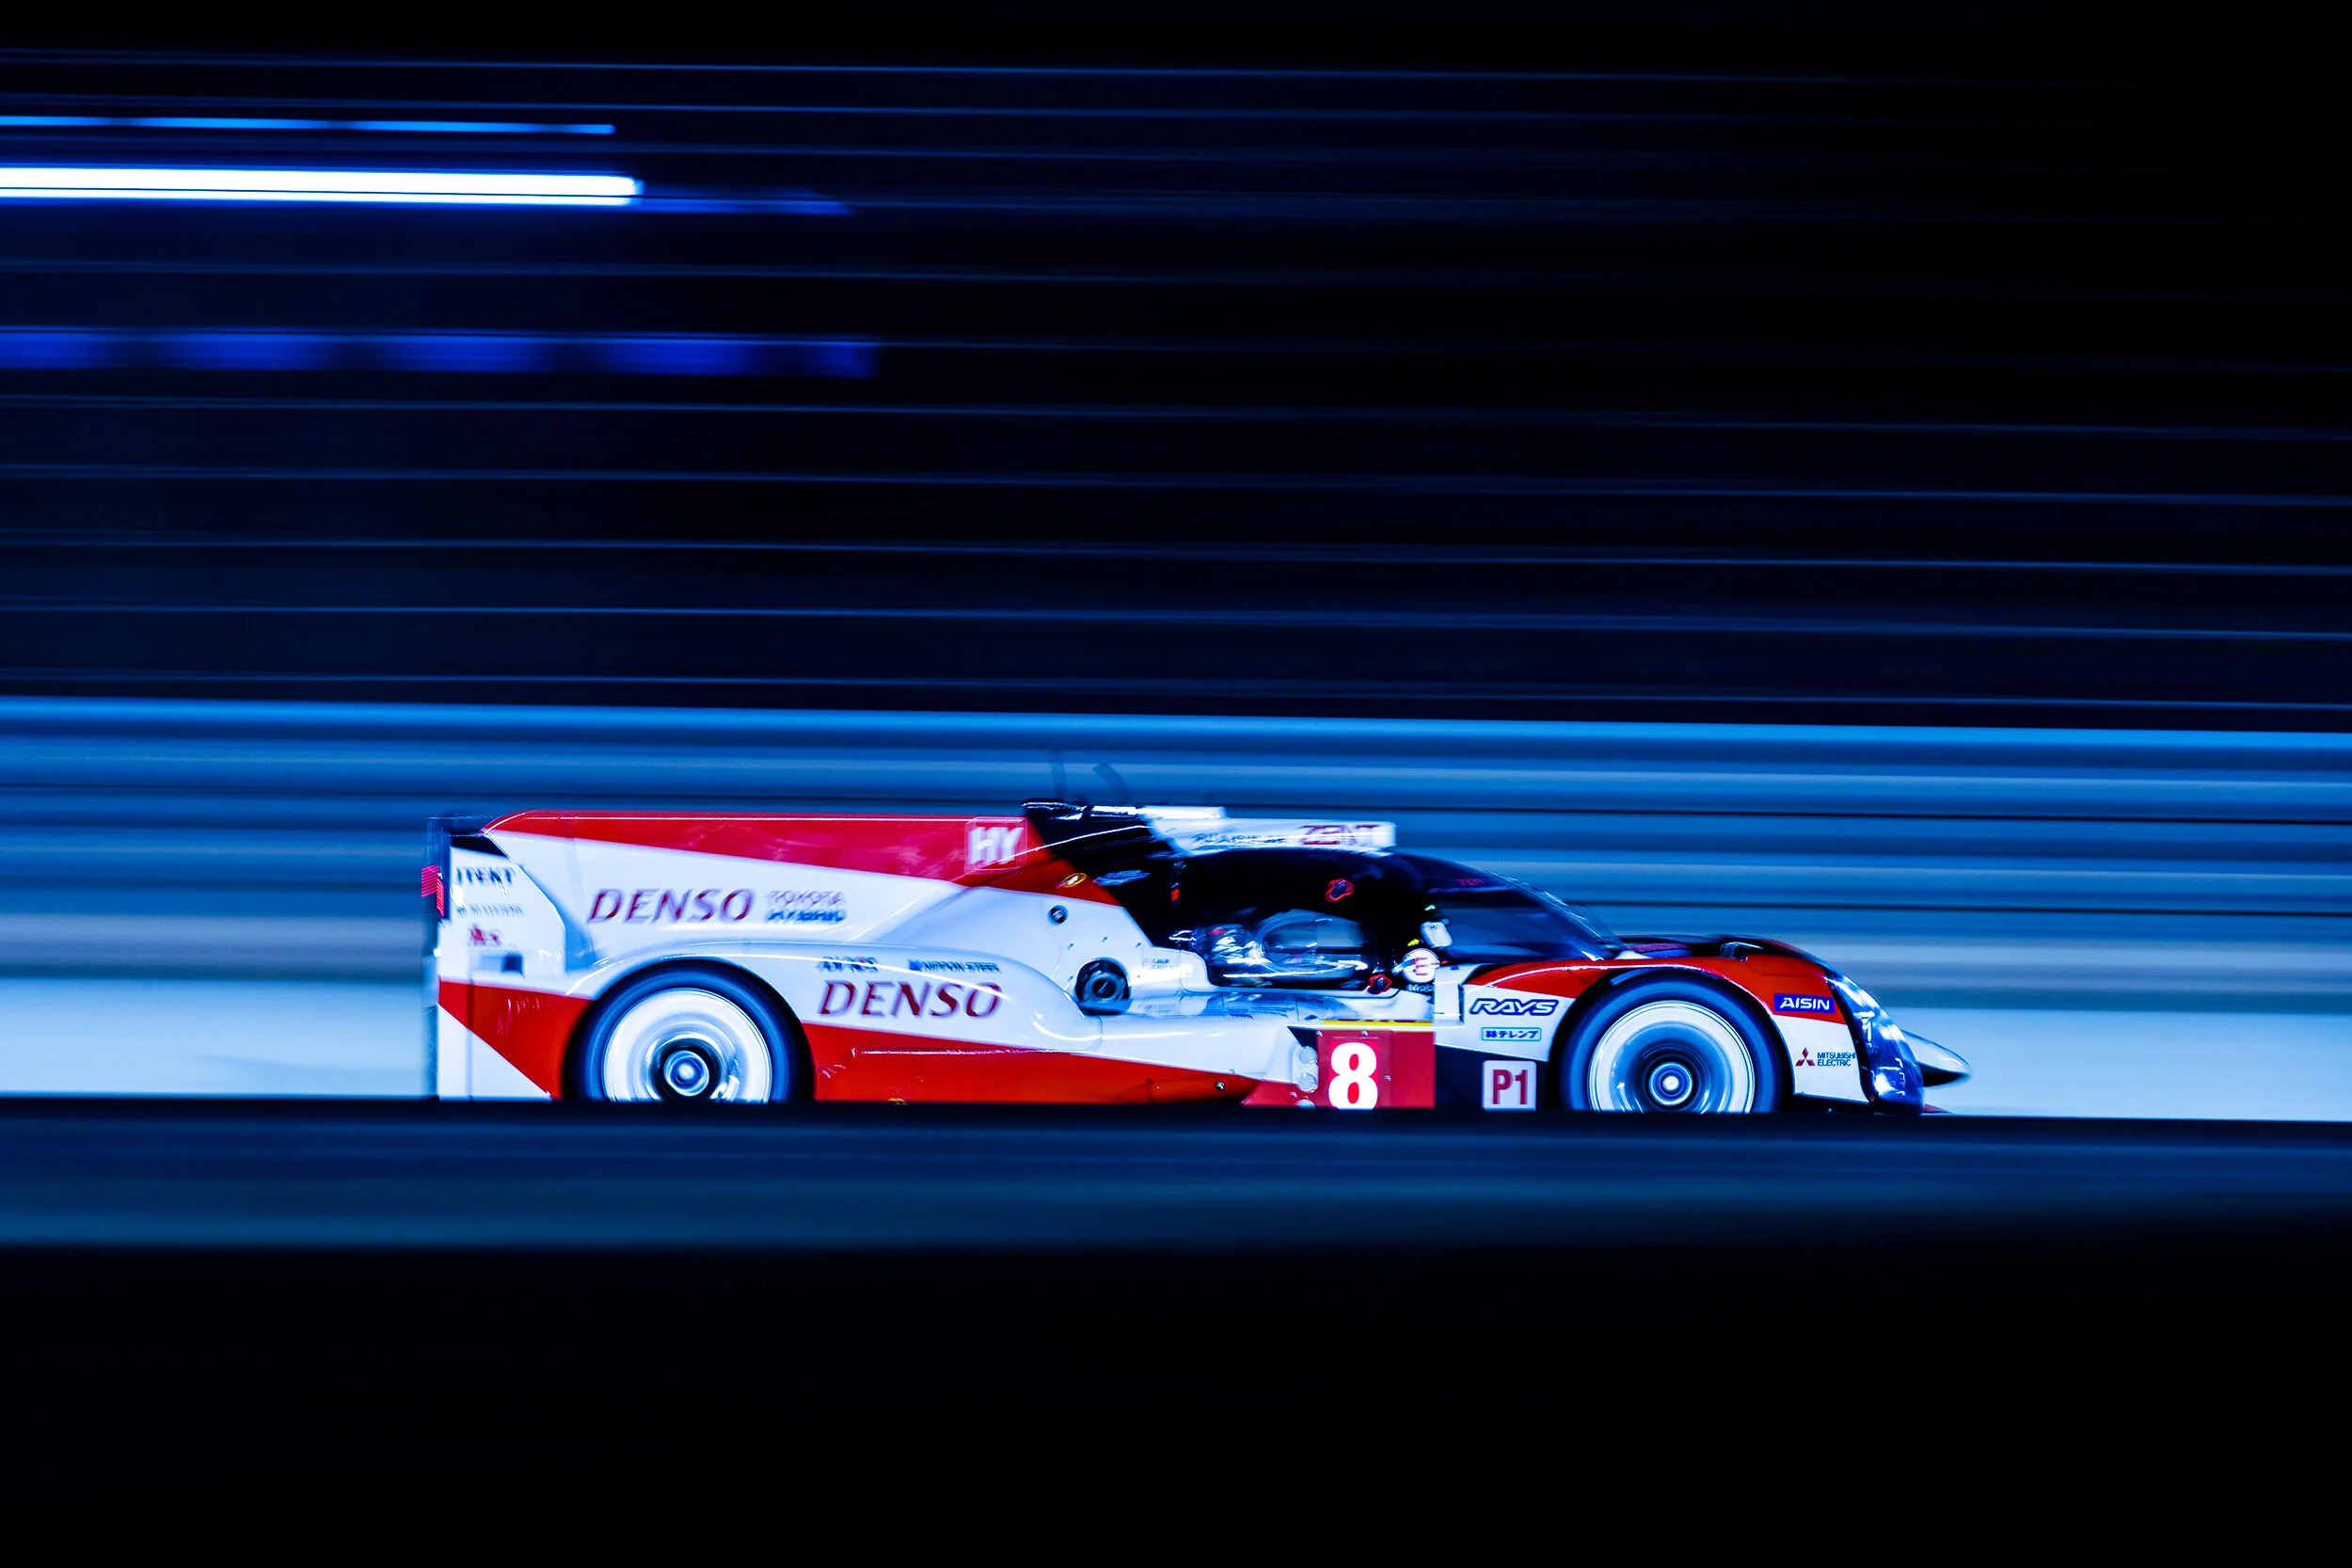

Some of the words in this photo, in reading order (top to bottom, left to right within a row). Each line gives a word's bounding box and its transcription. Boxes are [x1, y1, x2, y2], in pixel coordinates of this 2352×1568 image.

[969, 826, 1024, 865] HY
[587, 888, 755, 924] DENSO
[767, 890, 846, 907] TOYOTA
[817, 980, 1004, 1018] DENSO
[1470, 998, 1559, 1016] RAYS
[1779, 997, 1830, 1010] AISIN
[1328, 1041, 1378, 1110] 8
[1492, 1069, 1529, 1105] P1
